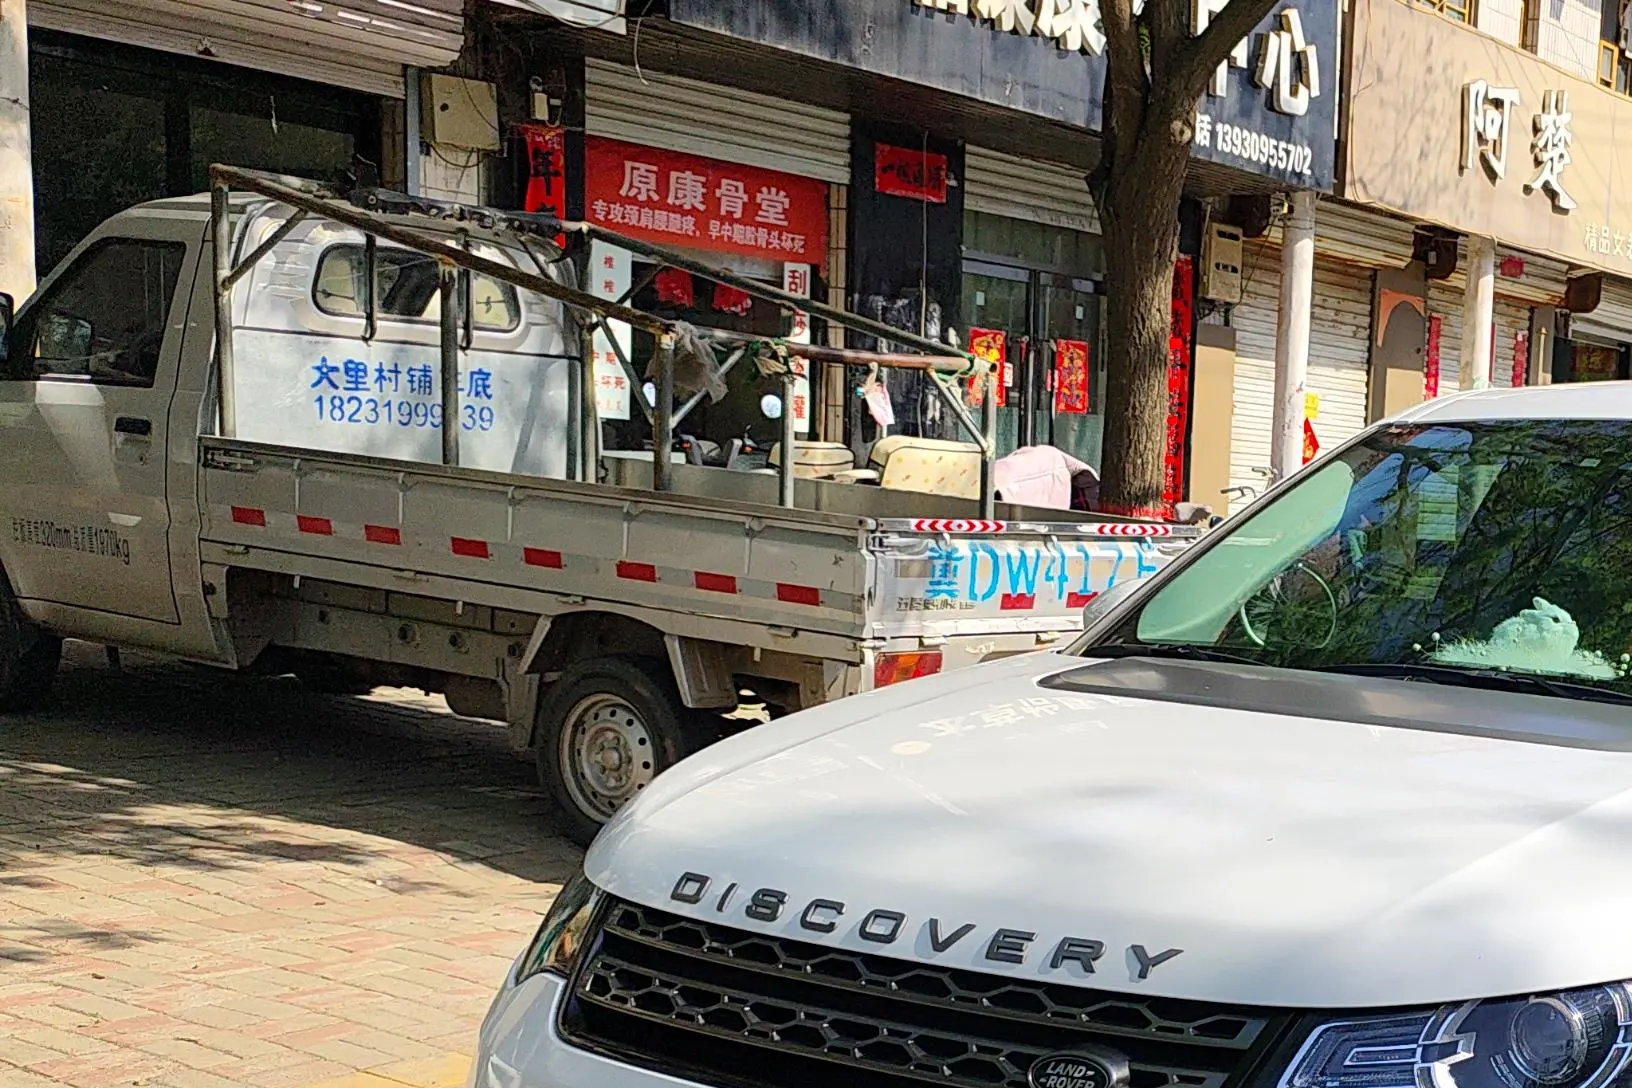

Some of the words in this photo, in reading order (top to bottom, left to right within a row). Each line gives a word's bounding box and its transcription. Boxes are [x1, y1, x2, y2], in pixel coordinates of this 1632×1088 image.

[1215, 122, 1312, 175] 13930955702
[1468, 79, 1578, 210] 阿楚
[618, 159, 790, 227] 原康骨堂
[310, 355, 494, 401] 大里村铺底
[313, 394, 495, 432] 1823199939
[669, 870, 1185, 980] DISCOVERY
[1045, 1061, 1088, 1078] LAND
